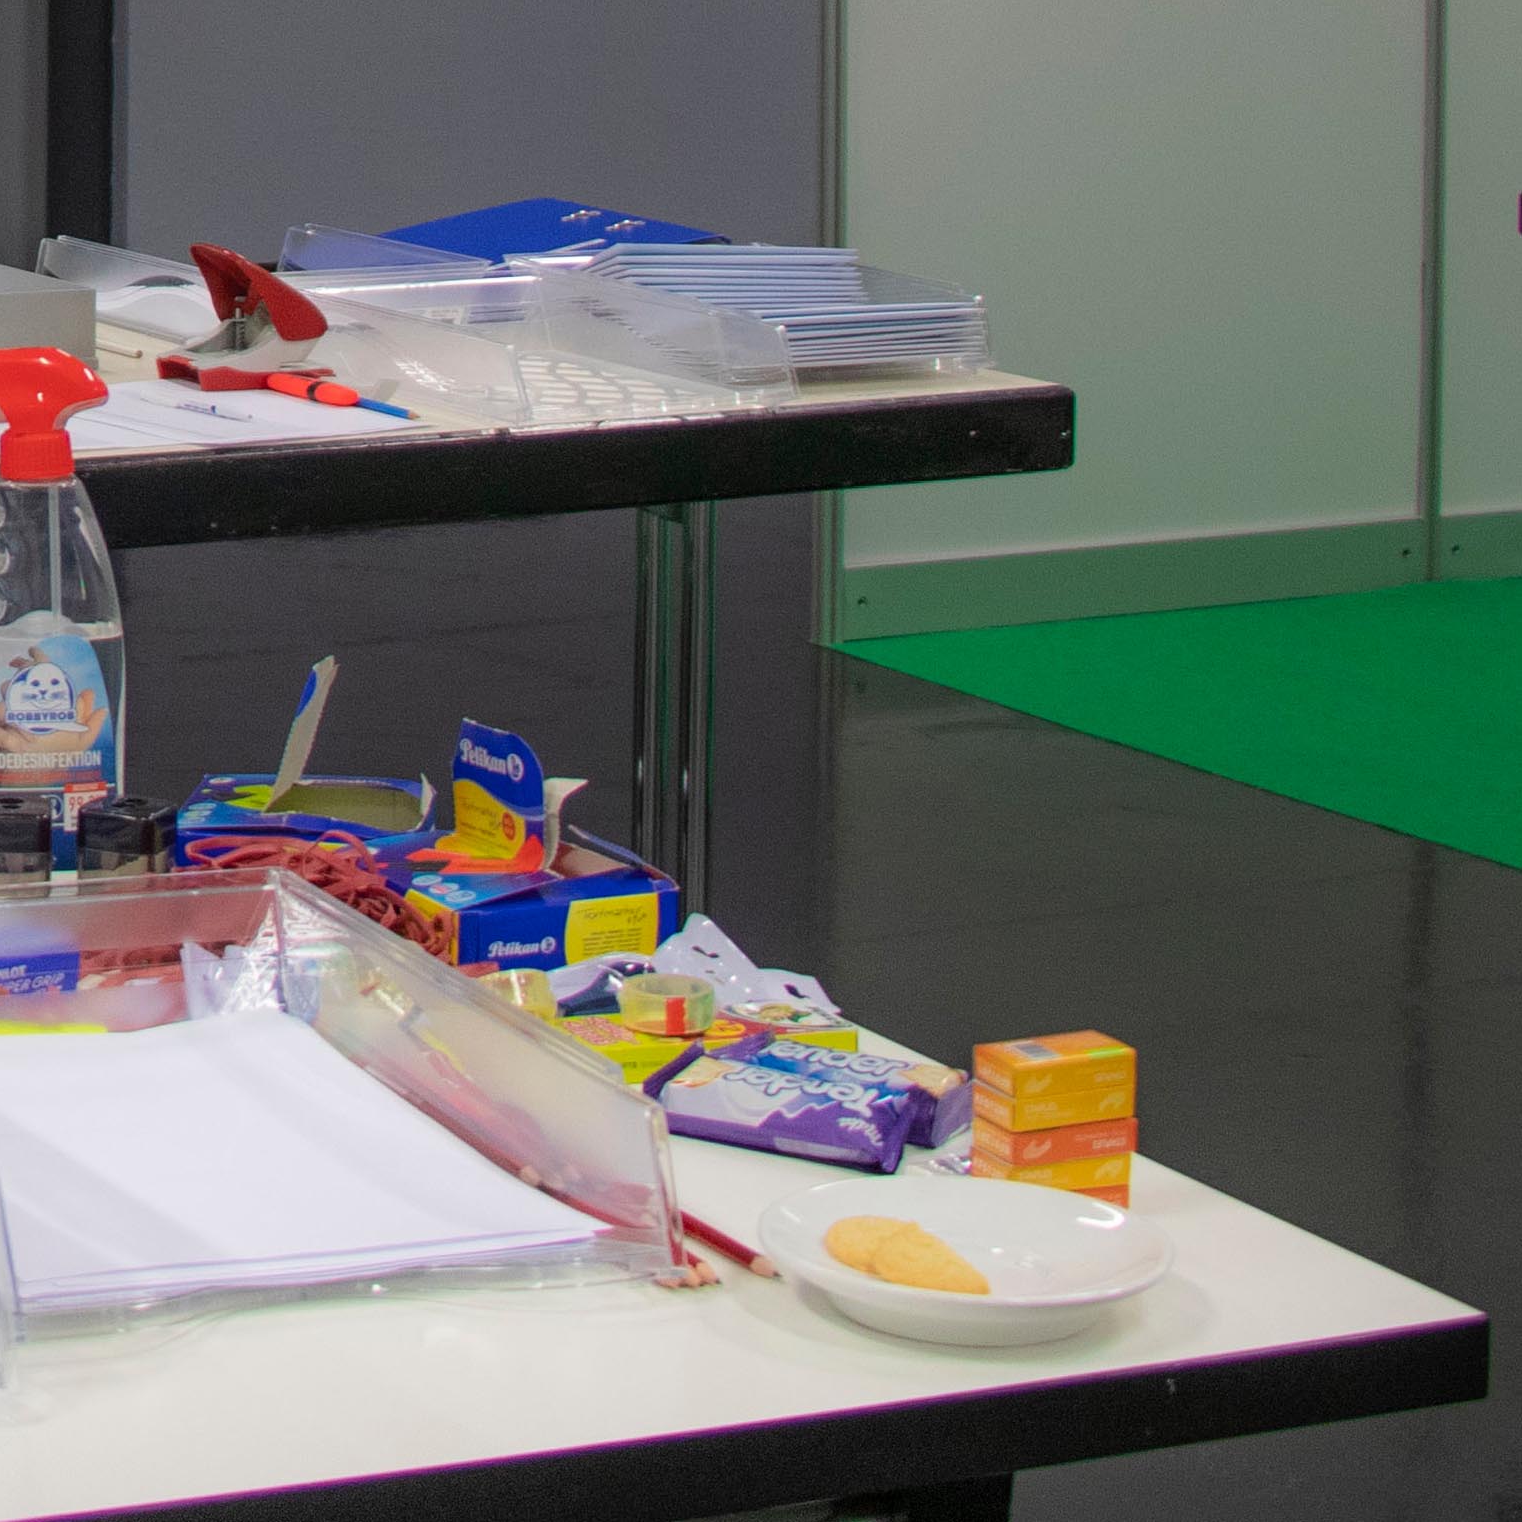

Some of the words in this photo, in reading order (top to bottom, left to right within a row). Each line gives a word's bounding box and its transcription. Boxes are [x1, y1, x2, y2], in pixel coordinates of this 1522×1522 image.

[459, 738, 507, 775] Pelikan
[487, 939, 540, 958] Pelikan
[722, 1064, 880, 1119] Tender
